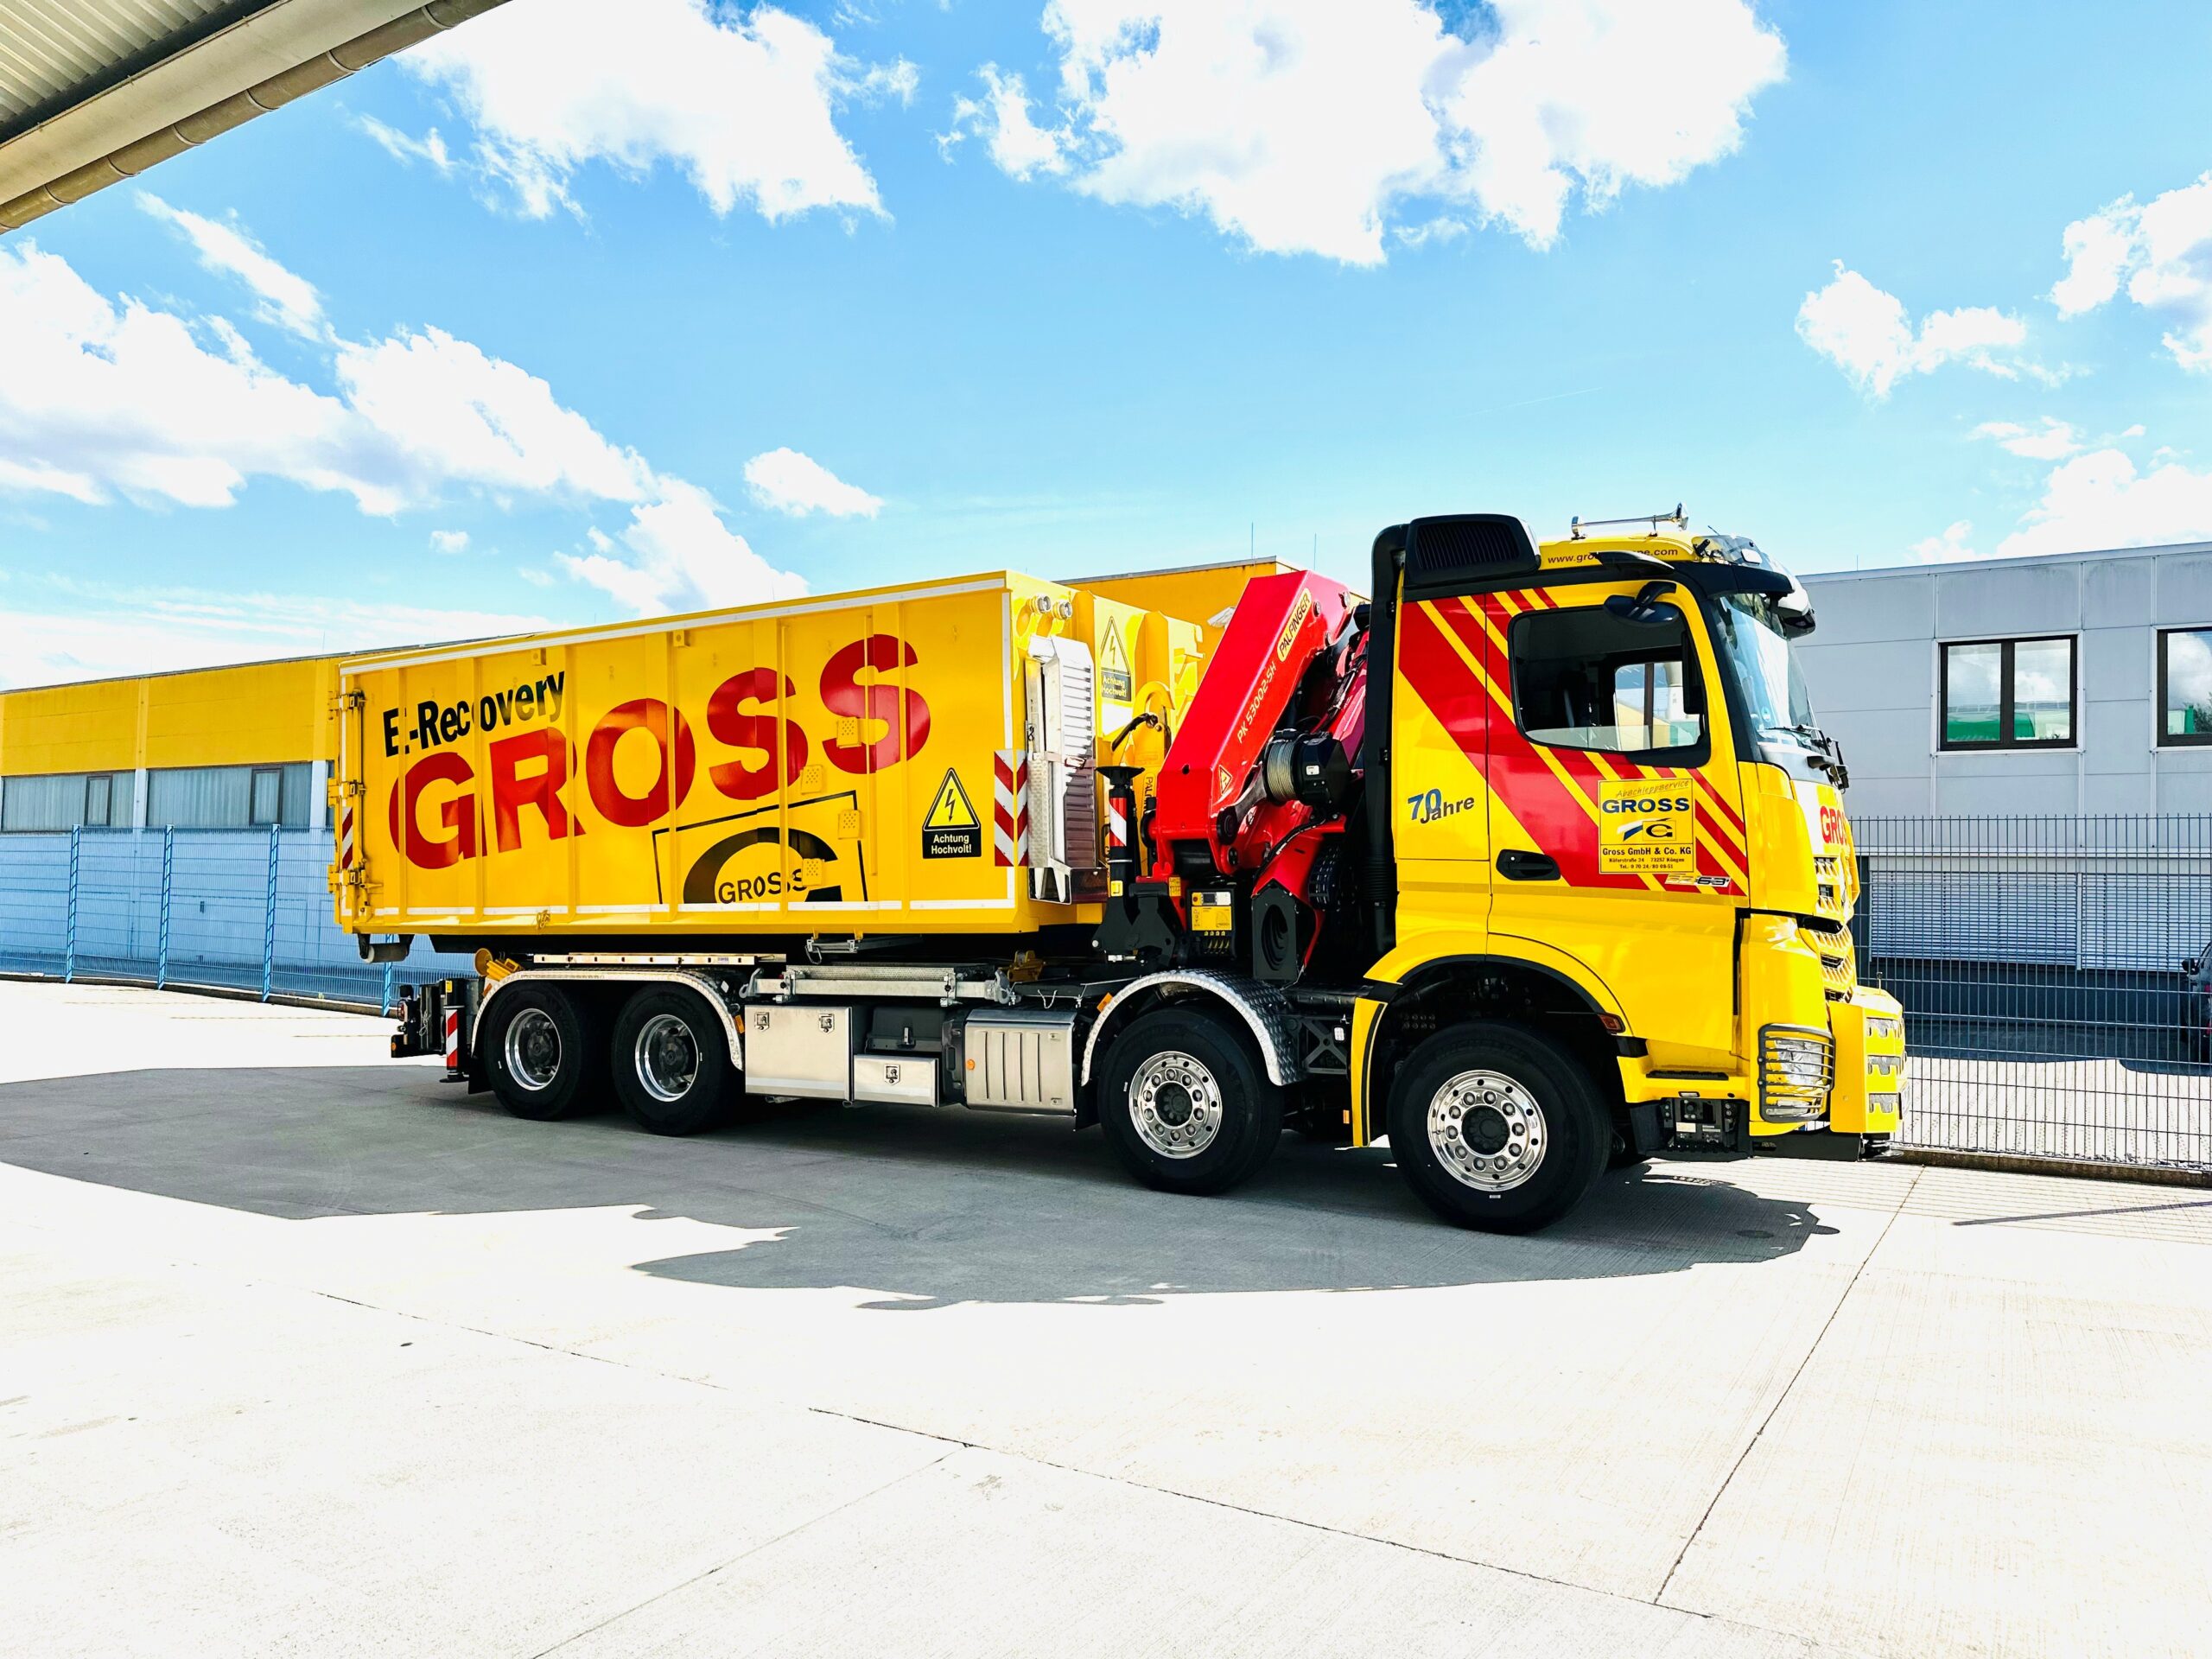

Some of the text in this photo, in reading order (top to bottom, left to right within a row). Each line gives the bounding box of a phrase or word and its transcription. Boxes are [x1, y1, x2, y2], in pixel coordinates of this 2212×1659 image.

[1279, 593, 1310, 657] PALFINGER
[384, 671, 564, 757] E-Recovery
[1237, 661, 1277, 744] PK 53002-SH
[389, 634, 931, 869] GROSS
[1408, 788, 1474, 823] 70 Jahre
[1602, 798, 1690, 813] GROSS
[931, 844, 972, 855] Hochvolt!
[933, 834, 969, 844] Achtung
[1628, 847, 1651, 855] GmbH
